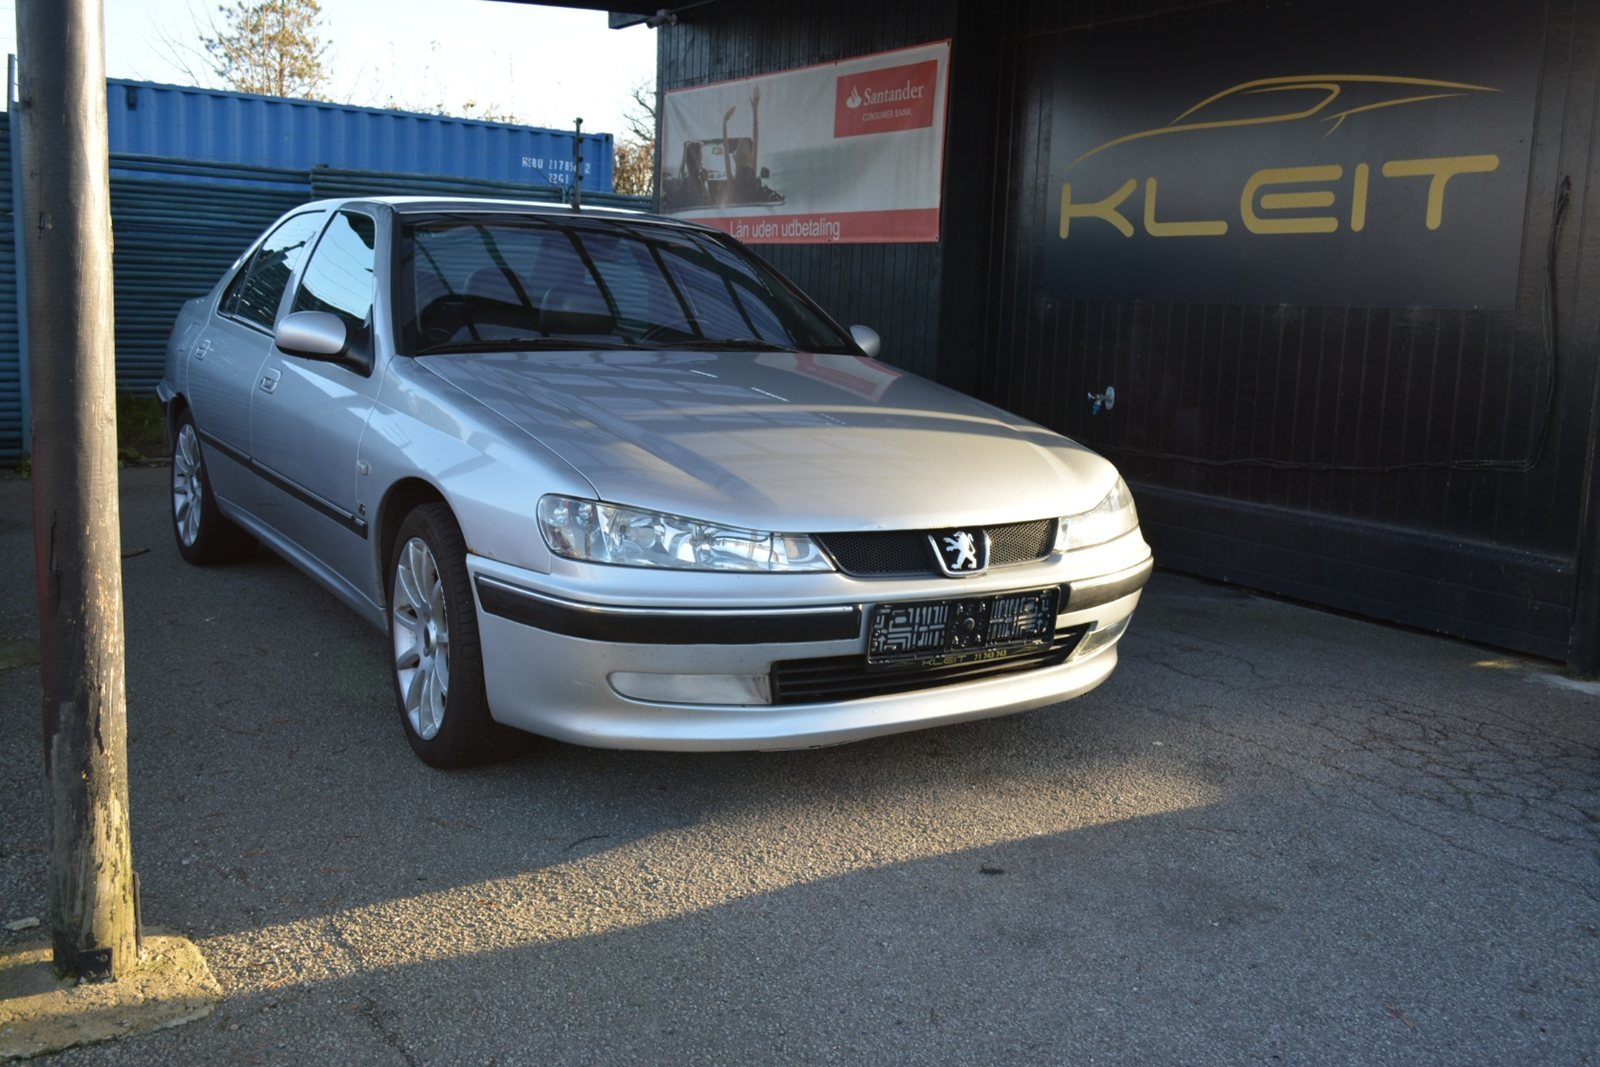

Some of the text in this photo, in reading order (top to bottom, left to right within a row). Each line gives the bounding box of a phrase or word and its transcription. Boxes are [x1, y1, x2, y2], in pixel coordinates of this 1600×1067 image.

[863, 80, 924, 106] Santander
[862, 108, 912, 121] CONSUMER BANK
[584, 163, 591, 174] 2
[1059, 154, 1499, 239] KLEIT
[730, 217, 840, 240] Lån uden udbetaling
[922, 655, 966, 666] KLEIT
